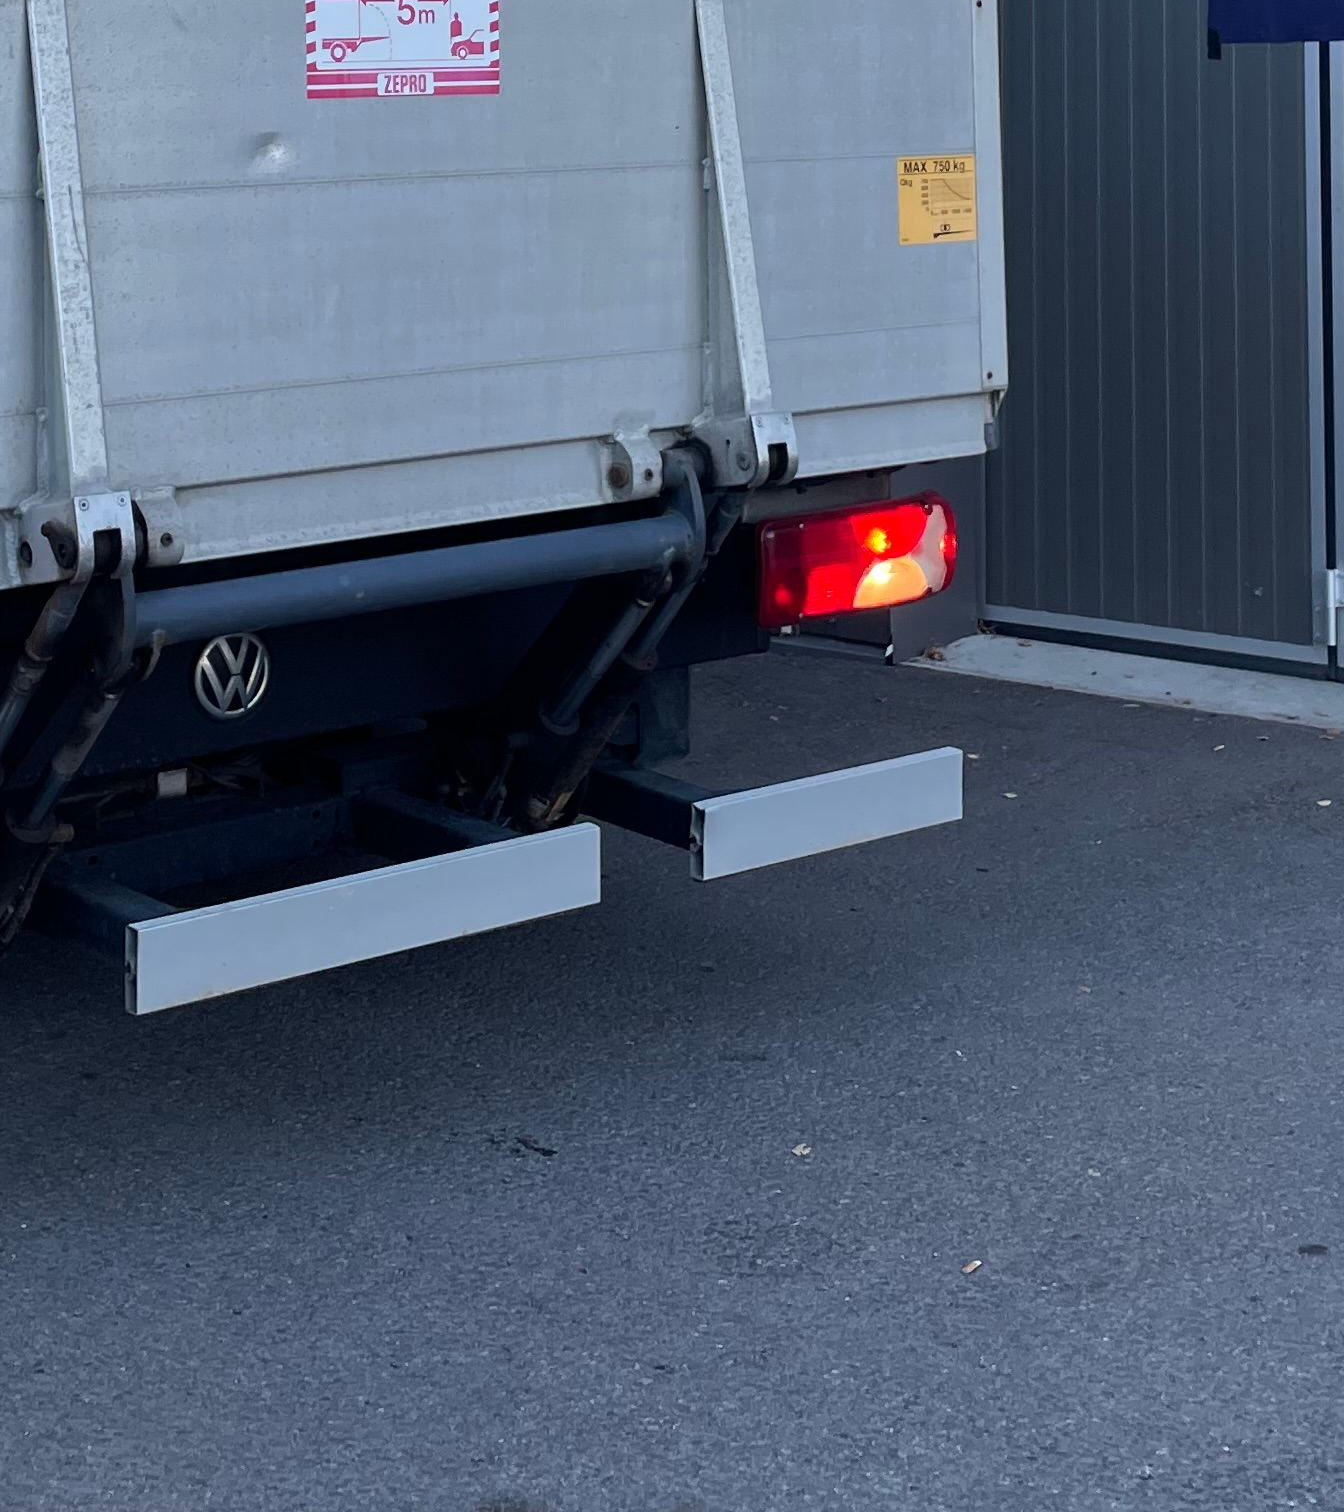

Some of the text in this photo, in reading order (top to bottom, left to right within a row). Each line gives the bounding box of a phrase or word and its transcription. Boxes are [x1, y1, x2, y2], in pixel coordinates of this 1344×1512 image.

[383, 73, 428, 94] ZEPRO
[903, 159, 966, 174] MAX 750 kg
